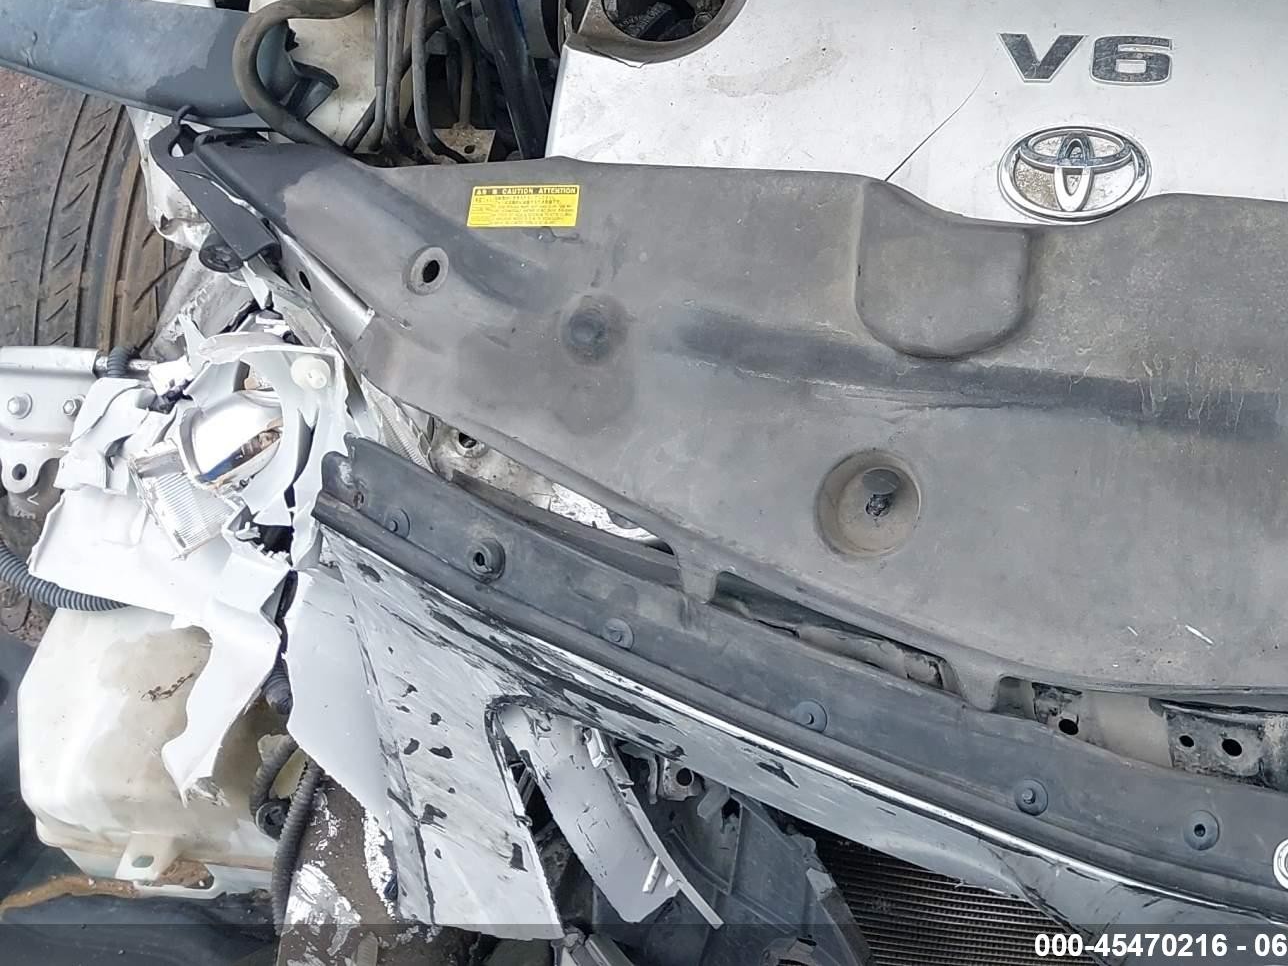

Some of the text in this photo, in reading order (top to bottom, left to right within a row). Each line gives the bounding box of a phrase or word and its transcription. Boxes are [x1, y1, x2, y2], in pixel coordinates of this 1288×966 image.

[998, 32, 1174, 86] V6
[502, 187, 534, 195] CAUTION
[538, 186, 577, 195] ATTENTION
